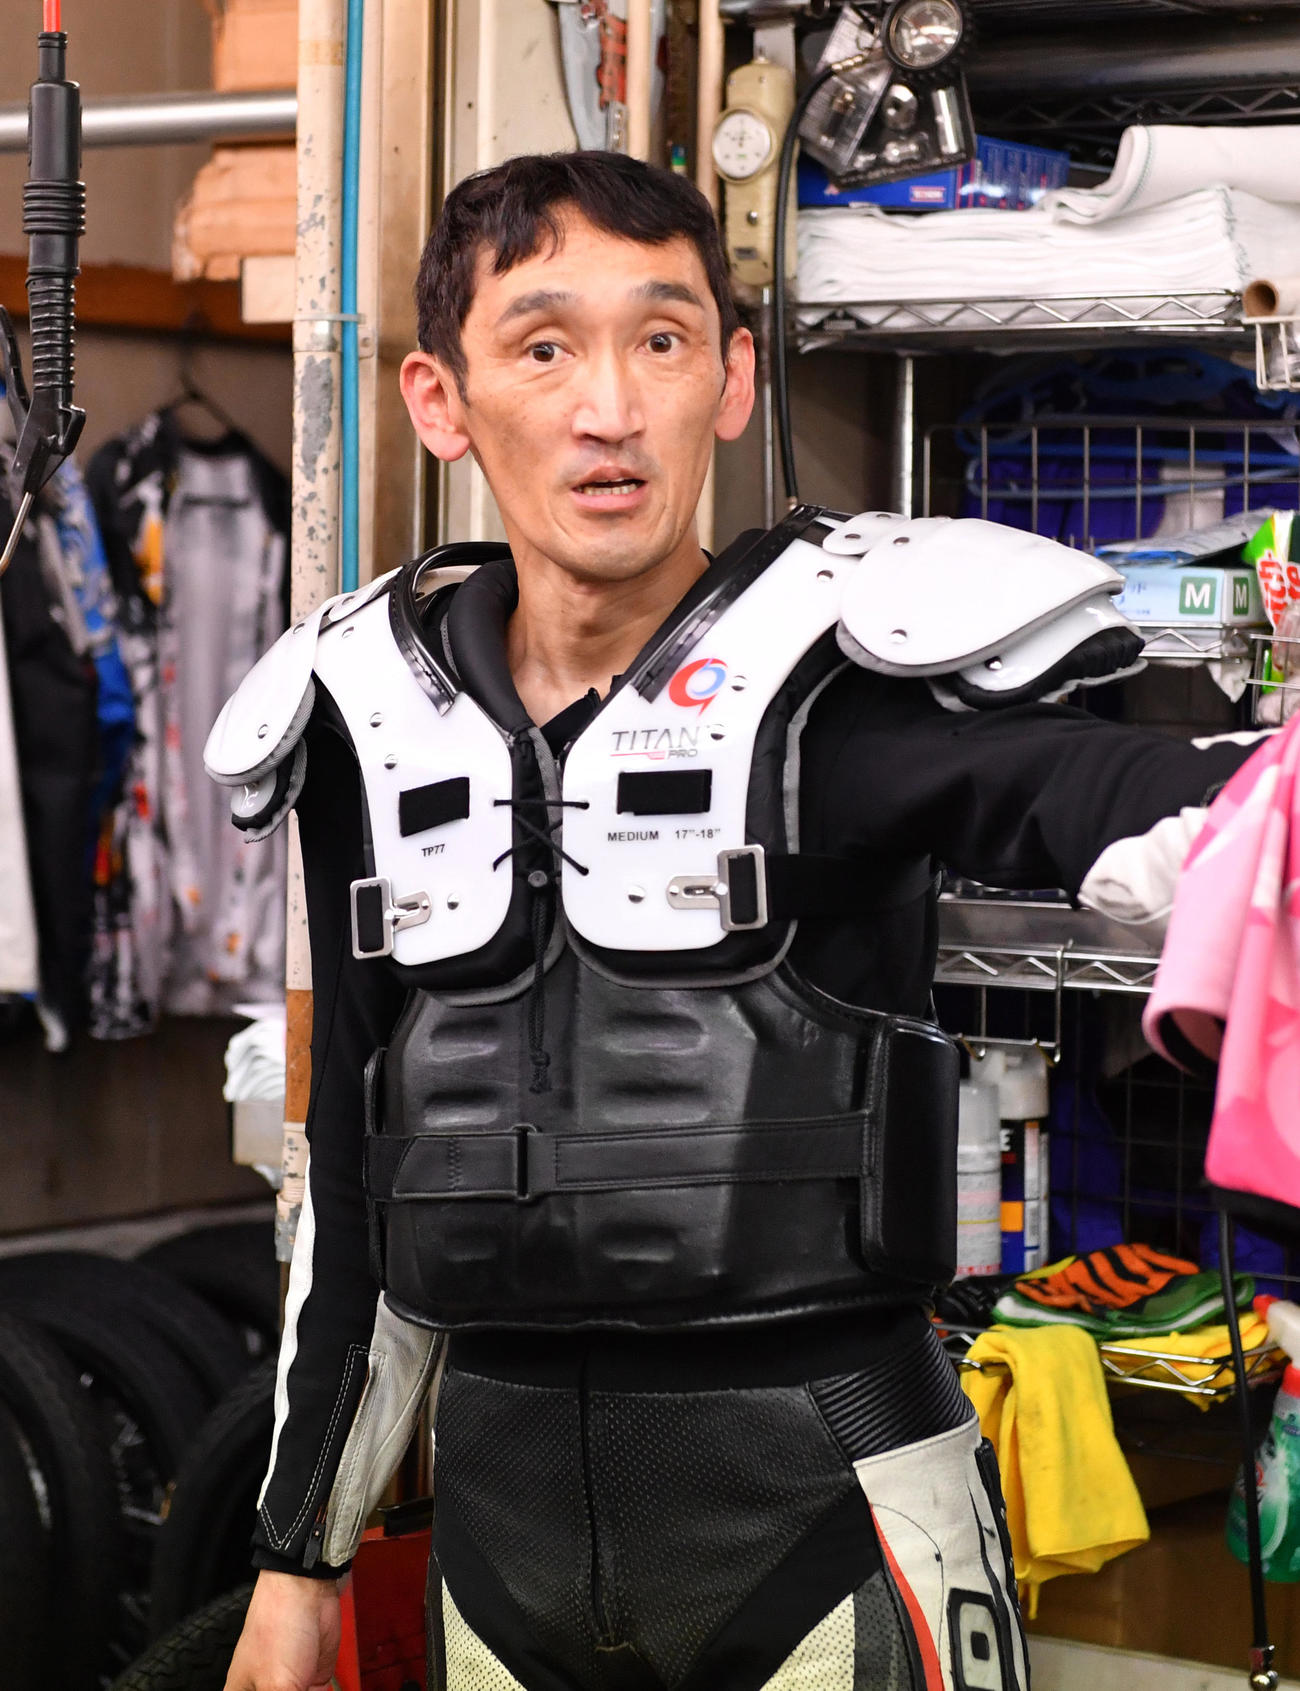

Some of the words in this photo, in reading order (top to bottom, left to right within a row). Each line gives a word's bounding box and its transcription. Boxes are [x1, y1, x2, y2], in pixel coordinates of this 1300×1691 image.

[1184, 582, 1211, 609] M
[1235, 584, 1247, 609] M
[612, 727, 700, 751] TITAN
[667, 748, 698, 760] PRO
[607, 830, 659, 842] MEDIUM
[421, 843, 445, 857] TP77
